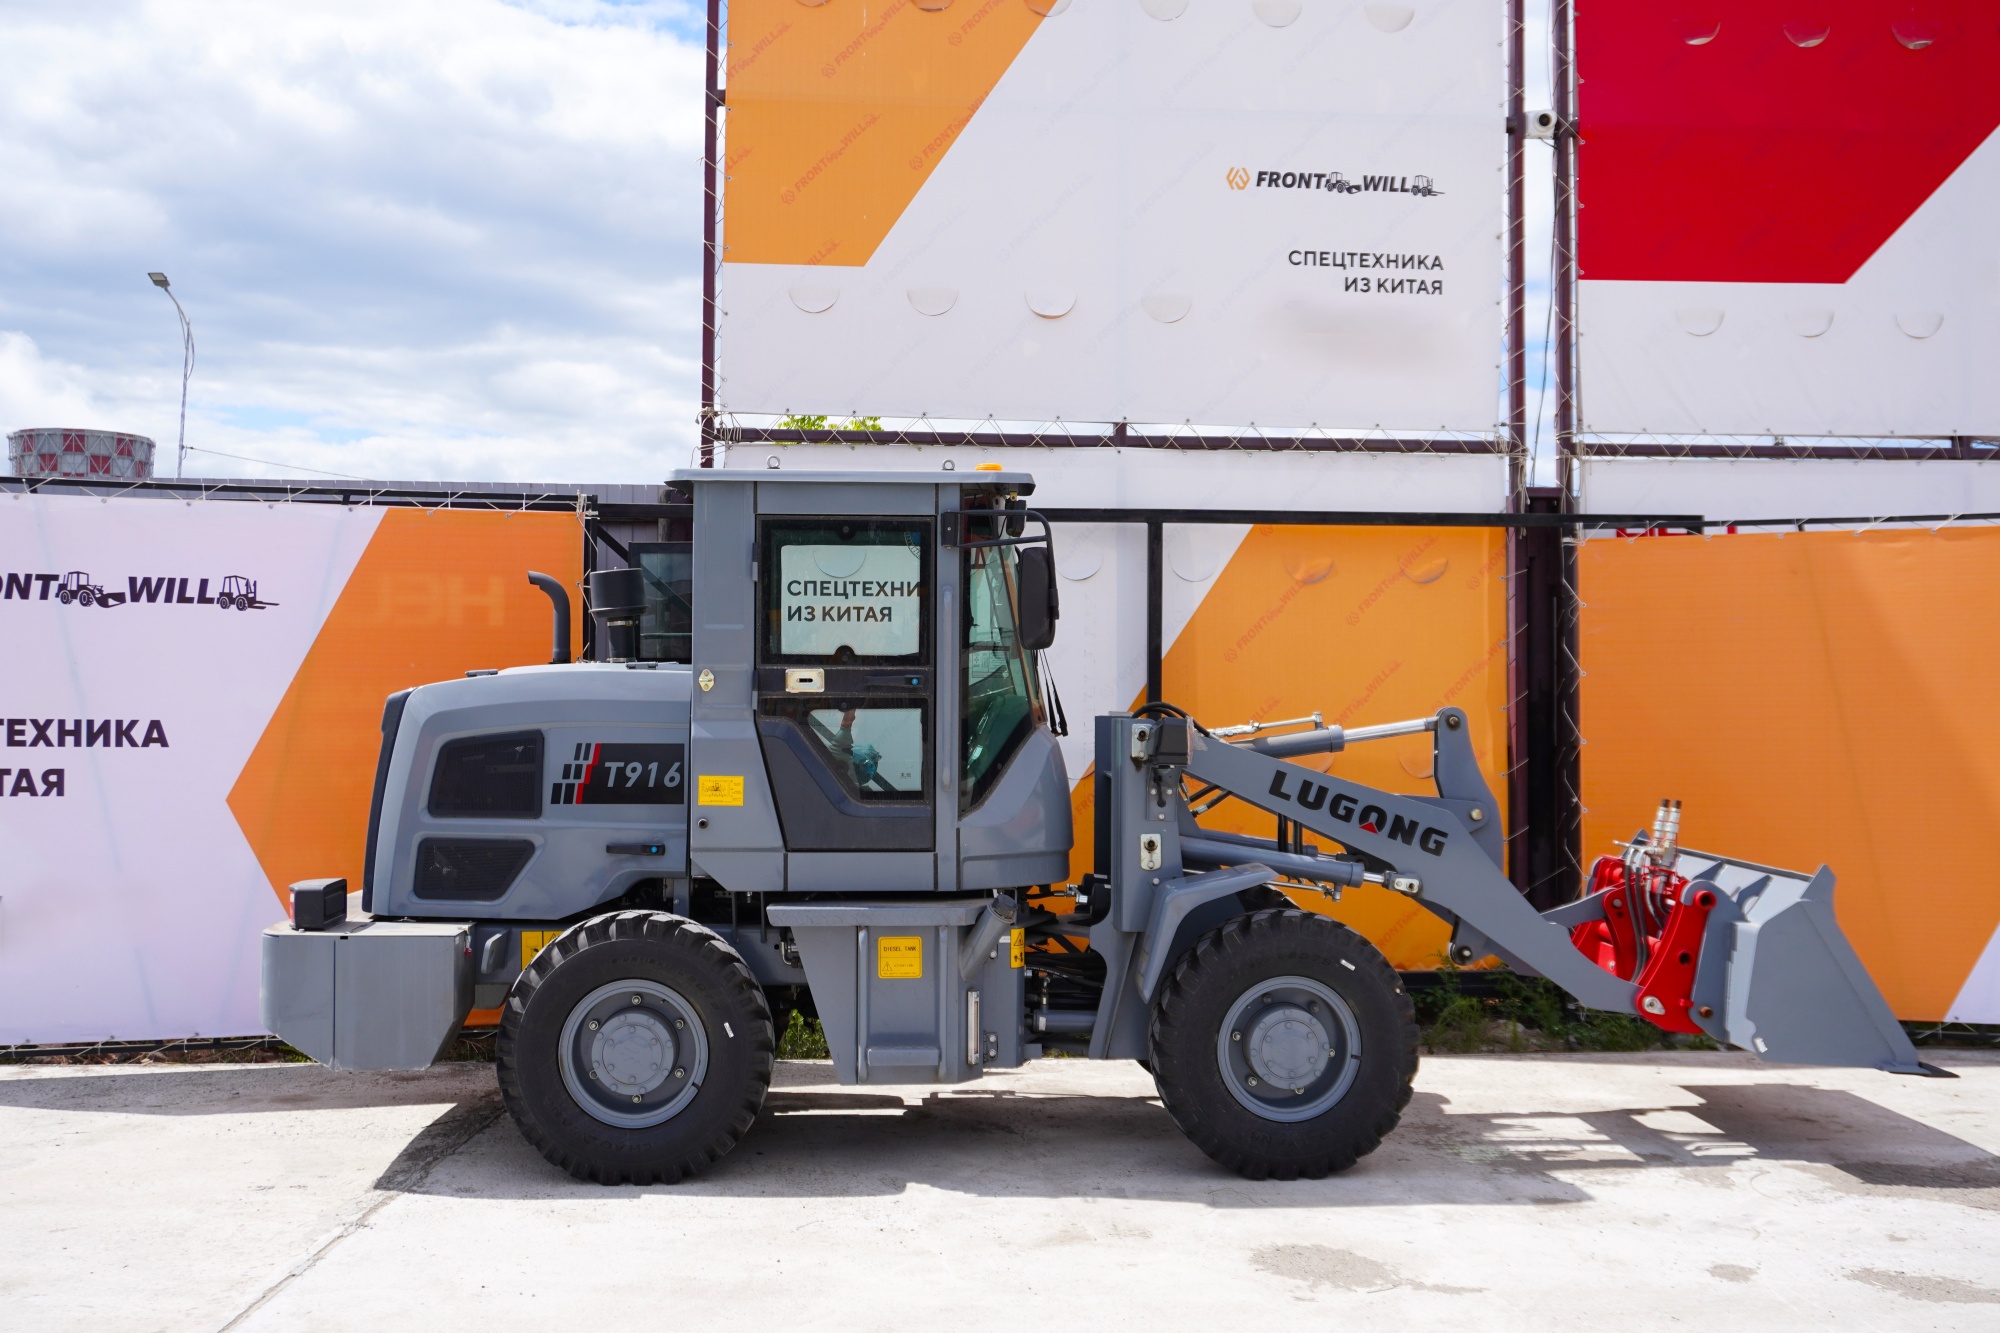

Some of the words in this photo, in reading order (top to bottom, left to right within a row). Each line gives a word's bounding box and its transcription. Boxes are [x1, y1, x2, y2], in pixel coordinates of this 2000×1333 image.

[1257, 171, 1324, 190] FRONT
[1363, 175, 1410, 193] WILL
[1288, 249, 1444, 271] СПЕЦТЕХНИКА
[1344, 276, 1371, 293] ИЗ
[1377, 278, 1443, 295] КИТАЯ
[128, 576, 217, 605] WILL
[787, 605, 816, 622] ИЗ
[822, 606, 892, 622] КИТАЯ
[0, 719, 170, 748] ЕХНИКА
[605, 761, 681, 788] T916
[1268, 770, 1449, 858] LUGONG
